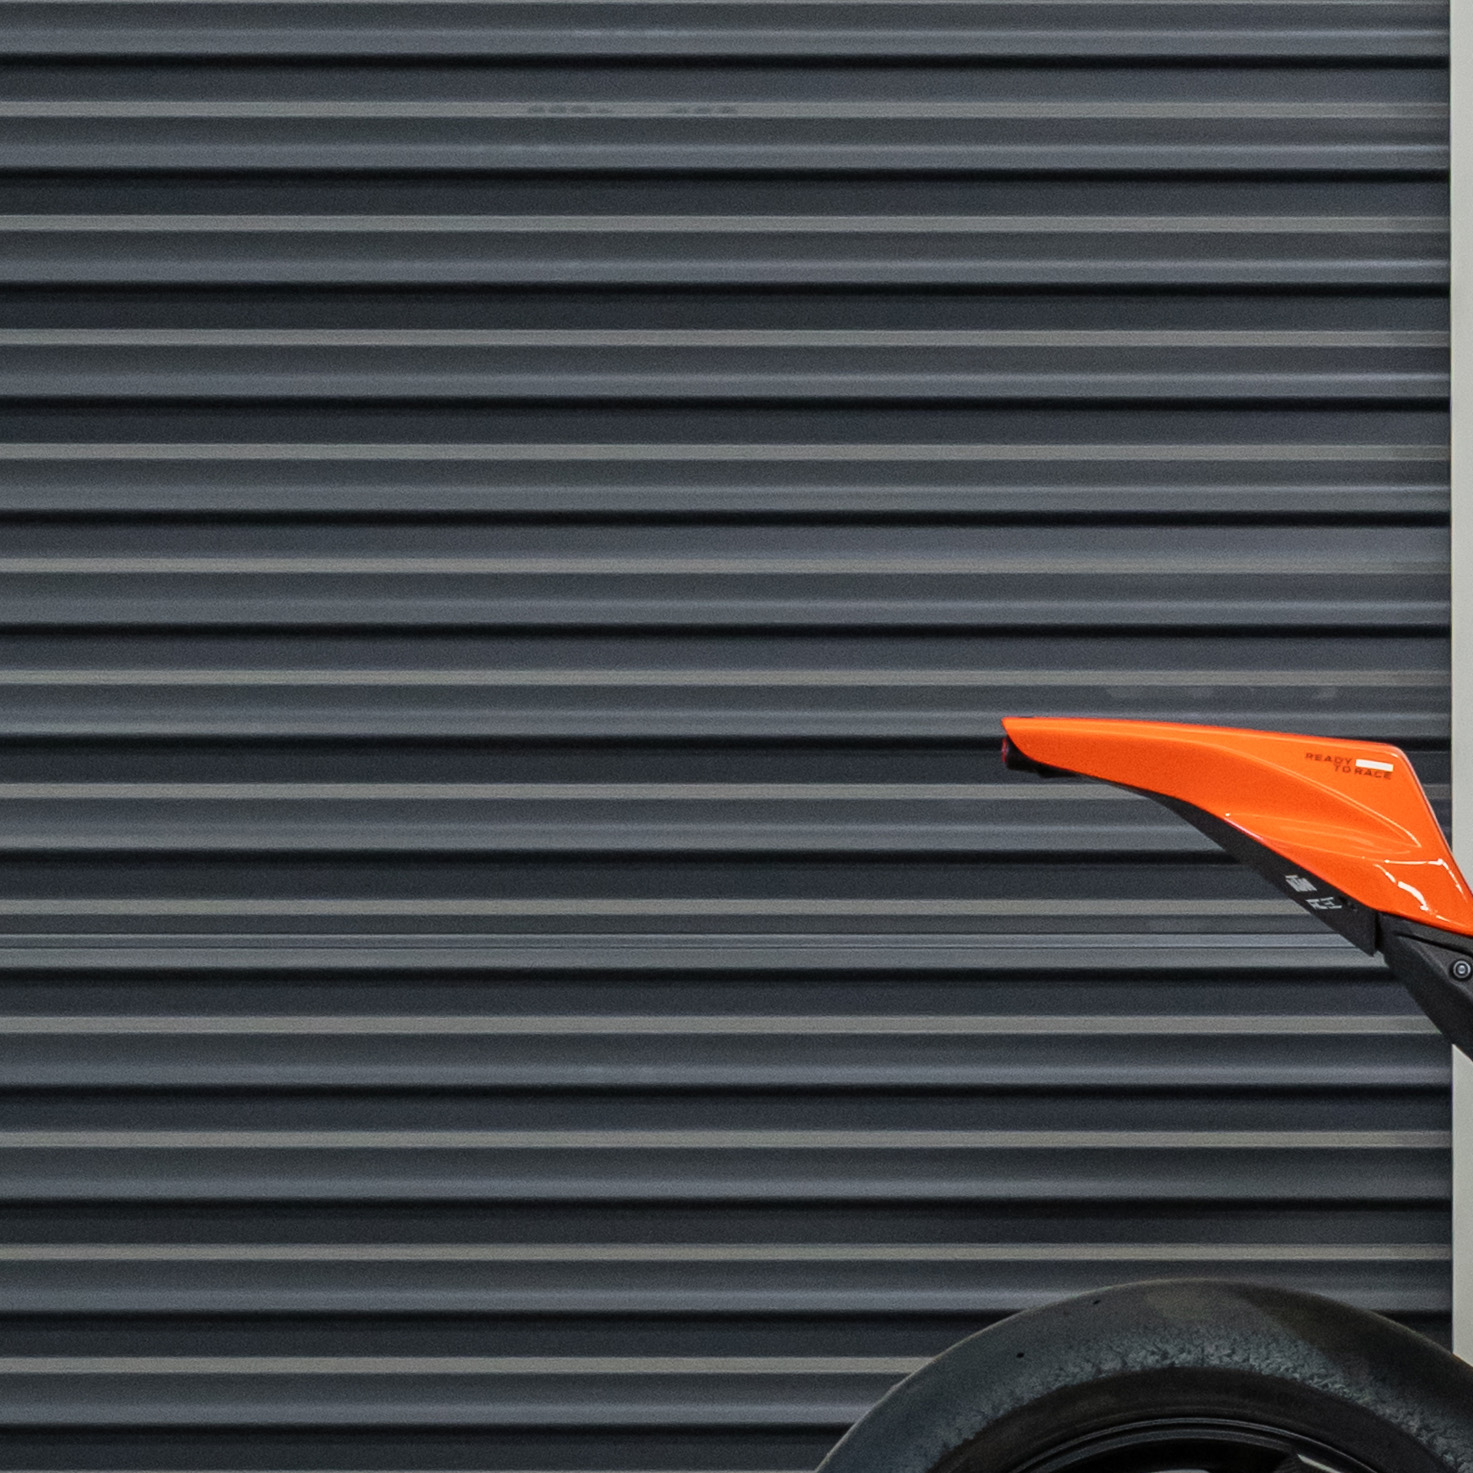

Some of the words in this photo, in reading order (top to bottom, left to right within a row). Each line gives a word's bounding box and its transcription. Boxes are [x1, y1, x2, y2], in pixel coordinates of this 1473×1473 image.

[1305, 752, 1352, 765] READY
[1334, 765, 1351, 774] TO
[1355, 767, 1393, 780] RACE
